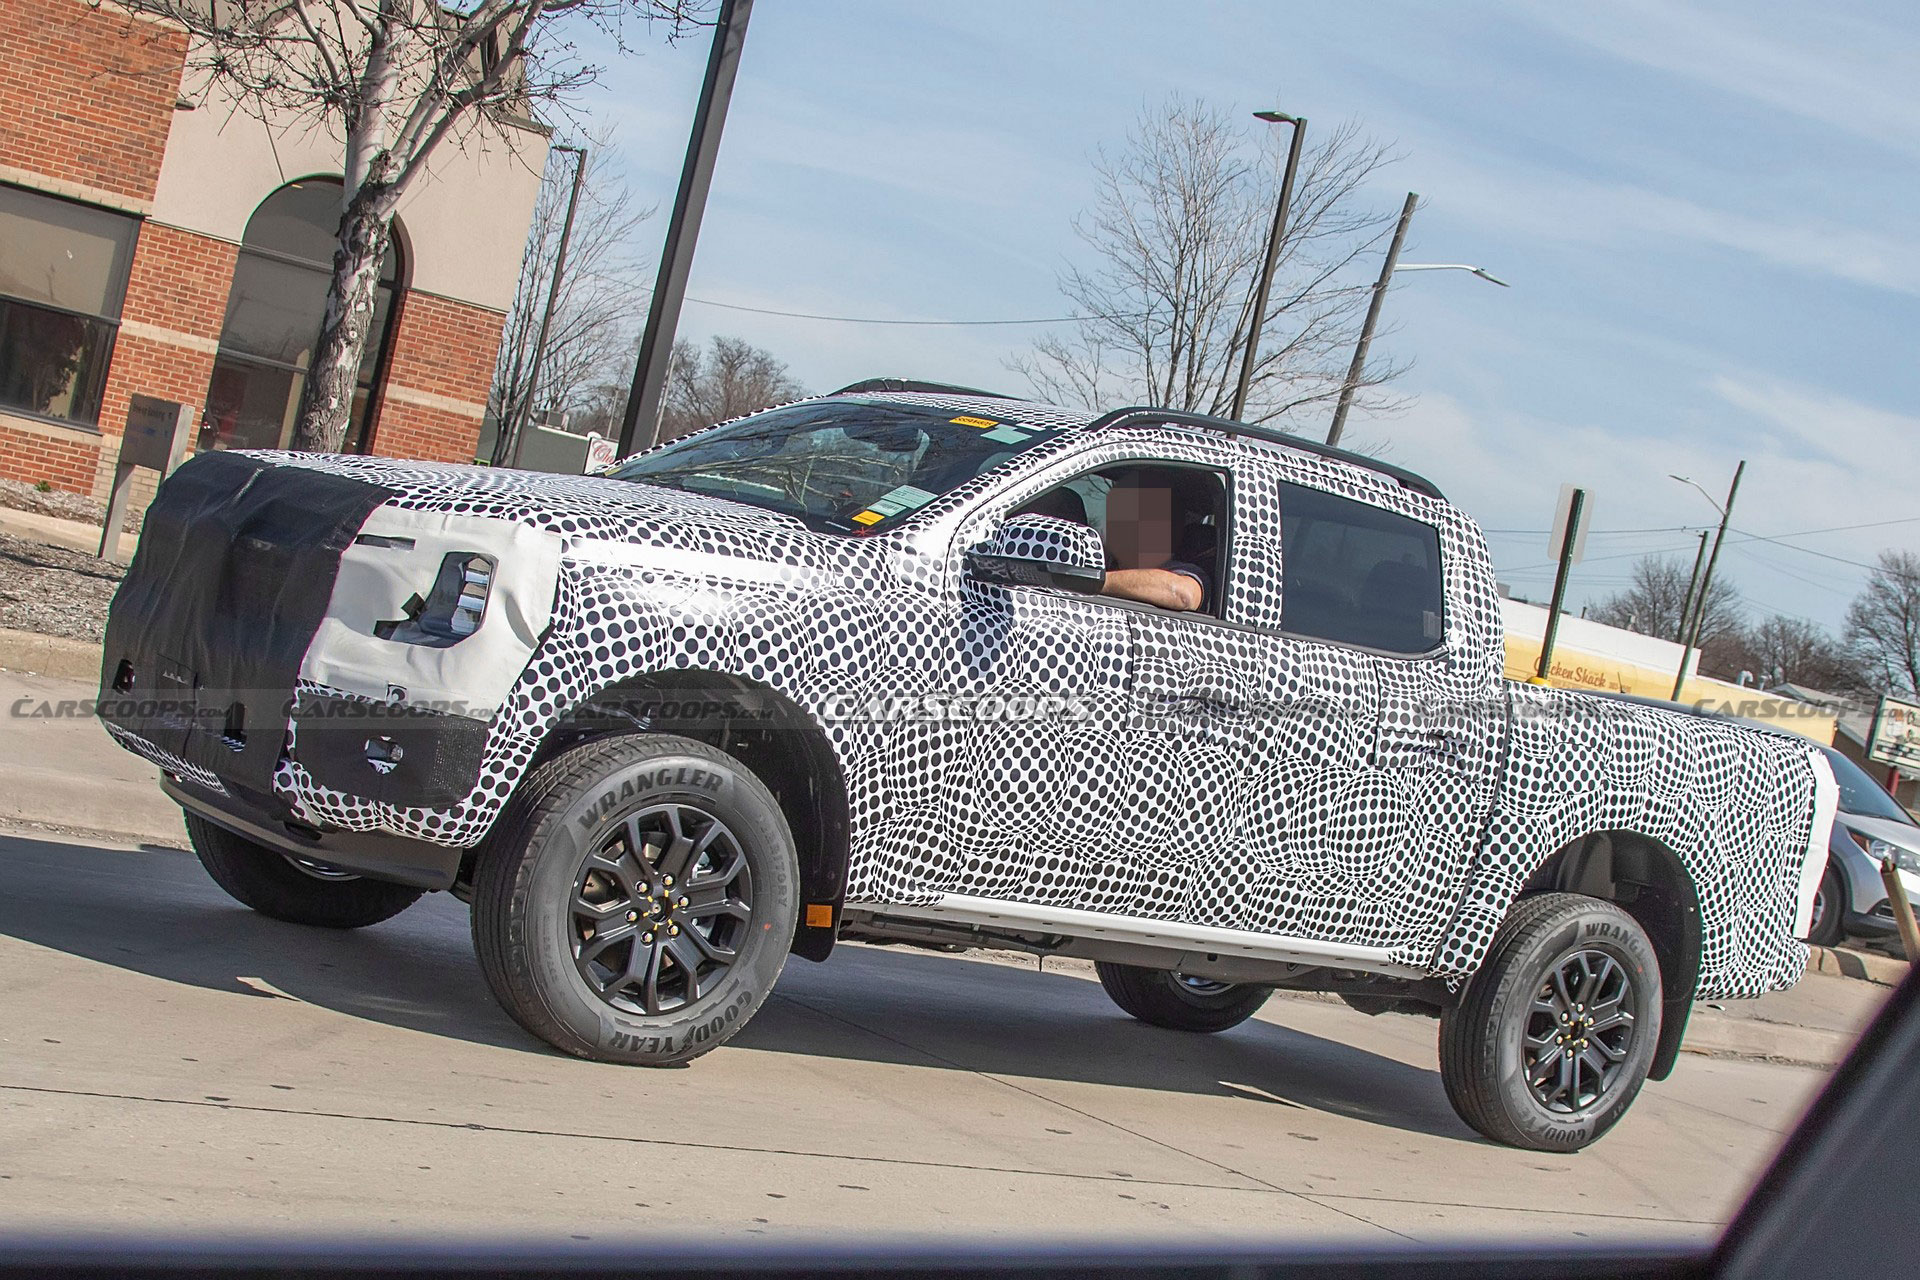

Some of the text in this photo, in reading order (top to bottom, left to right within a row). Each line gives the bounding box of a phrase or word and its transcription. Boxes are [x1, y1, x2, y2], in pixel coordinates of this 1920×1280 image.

[1533, 656, 1574, 680] Ccken
[1575, 667, 1606, 688] Shack
[577, 767, 724, 830] WRANGLER
